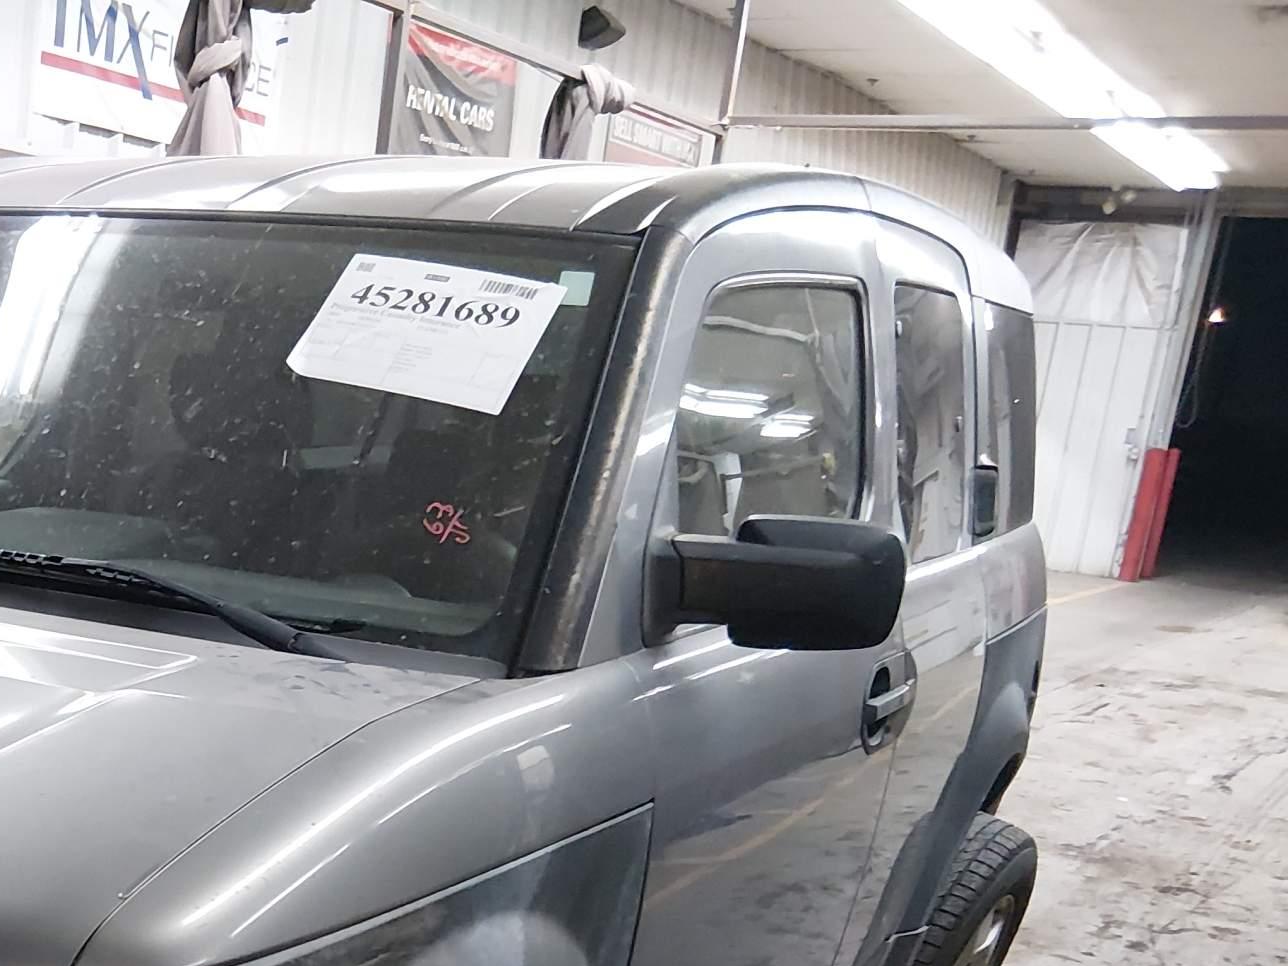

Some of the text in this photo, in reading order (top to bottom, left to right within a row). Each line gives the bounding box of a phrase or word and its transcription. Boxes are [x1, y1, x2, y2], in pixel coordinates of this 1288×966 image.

[406, 84, 495, 132] RENTAL CARS
[351, 283, 520, 328] 45281689
